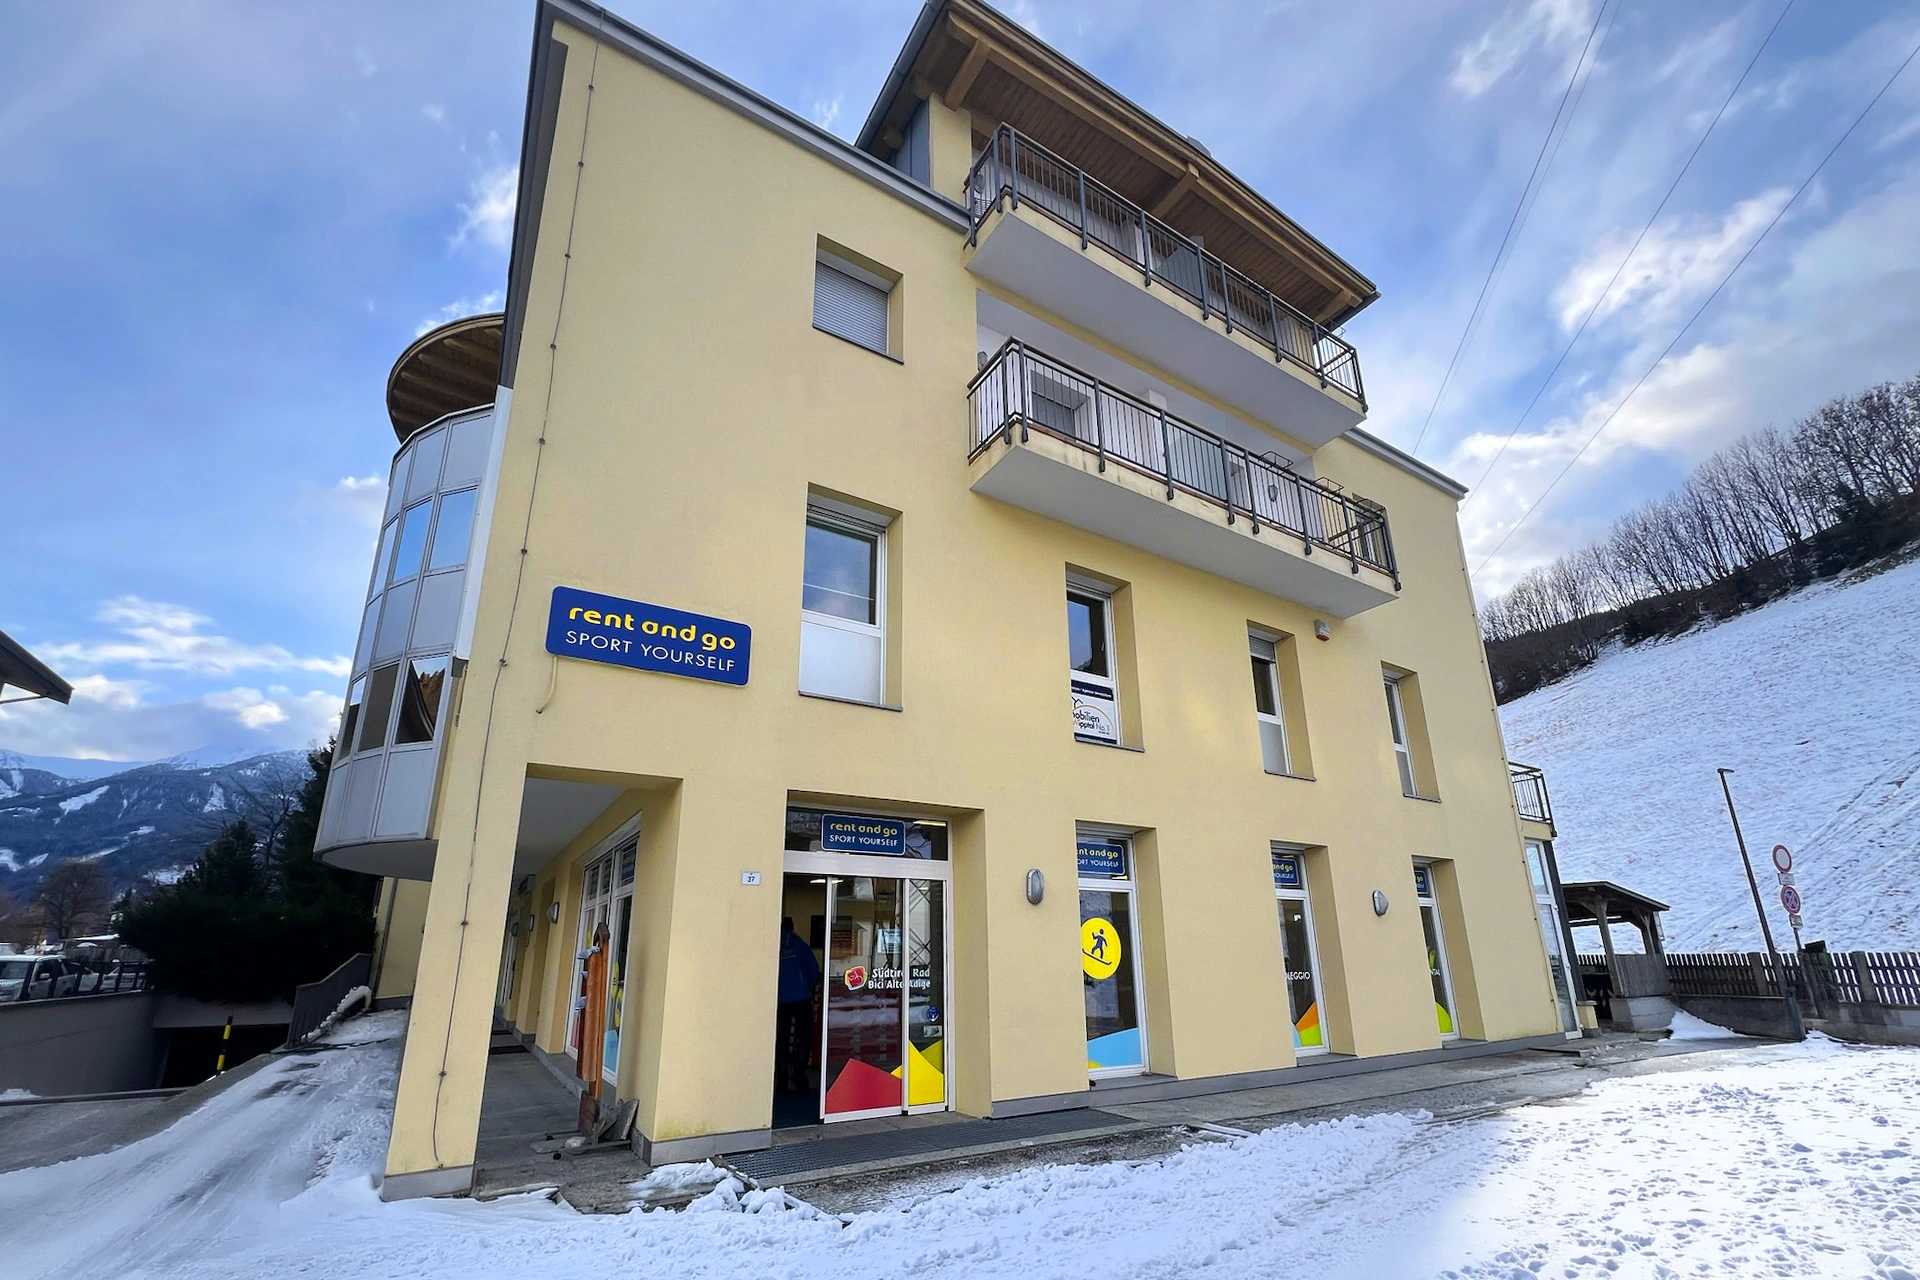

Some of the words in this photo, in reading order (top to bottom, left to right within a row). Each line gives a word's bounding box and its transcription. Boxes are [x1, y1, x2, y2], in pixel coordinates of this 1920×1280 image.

[569, 607, 635, 631] rent
[641, 620, 697, 642] and
[701, 632, 736, 651] go
[565, 630, 633, 653] SPORT
[640, 643, 735, 672] YOURSELF
[830, 823, 857, 832] rent
[858, 825, 881, 834] and
[883, 828, 898, 837] go
[829, 834, 856, 843] SPORT
[858, 836, 898, 847] YOURSELF
[1089, 849, 1106, 857] and
[1107, 851, 1118, 859] go
[913, 967, 930, 978] Rad
[868, 980, 884, 989] Bici
